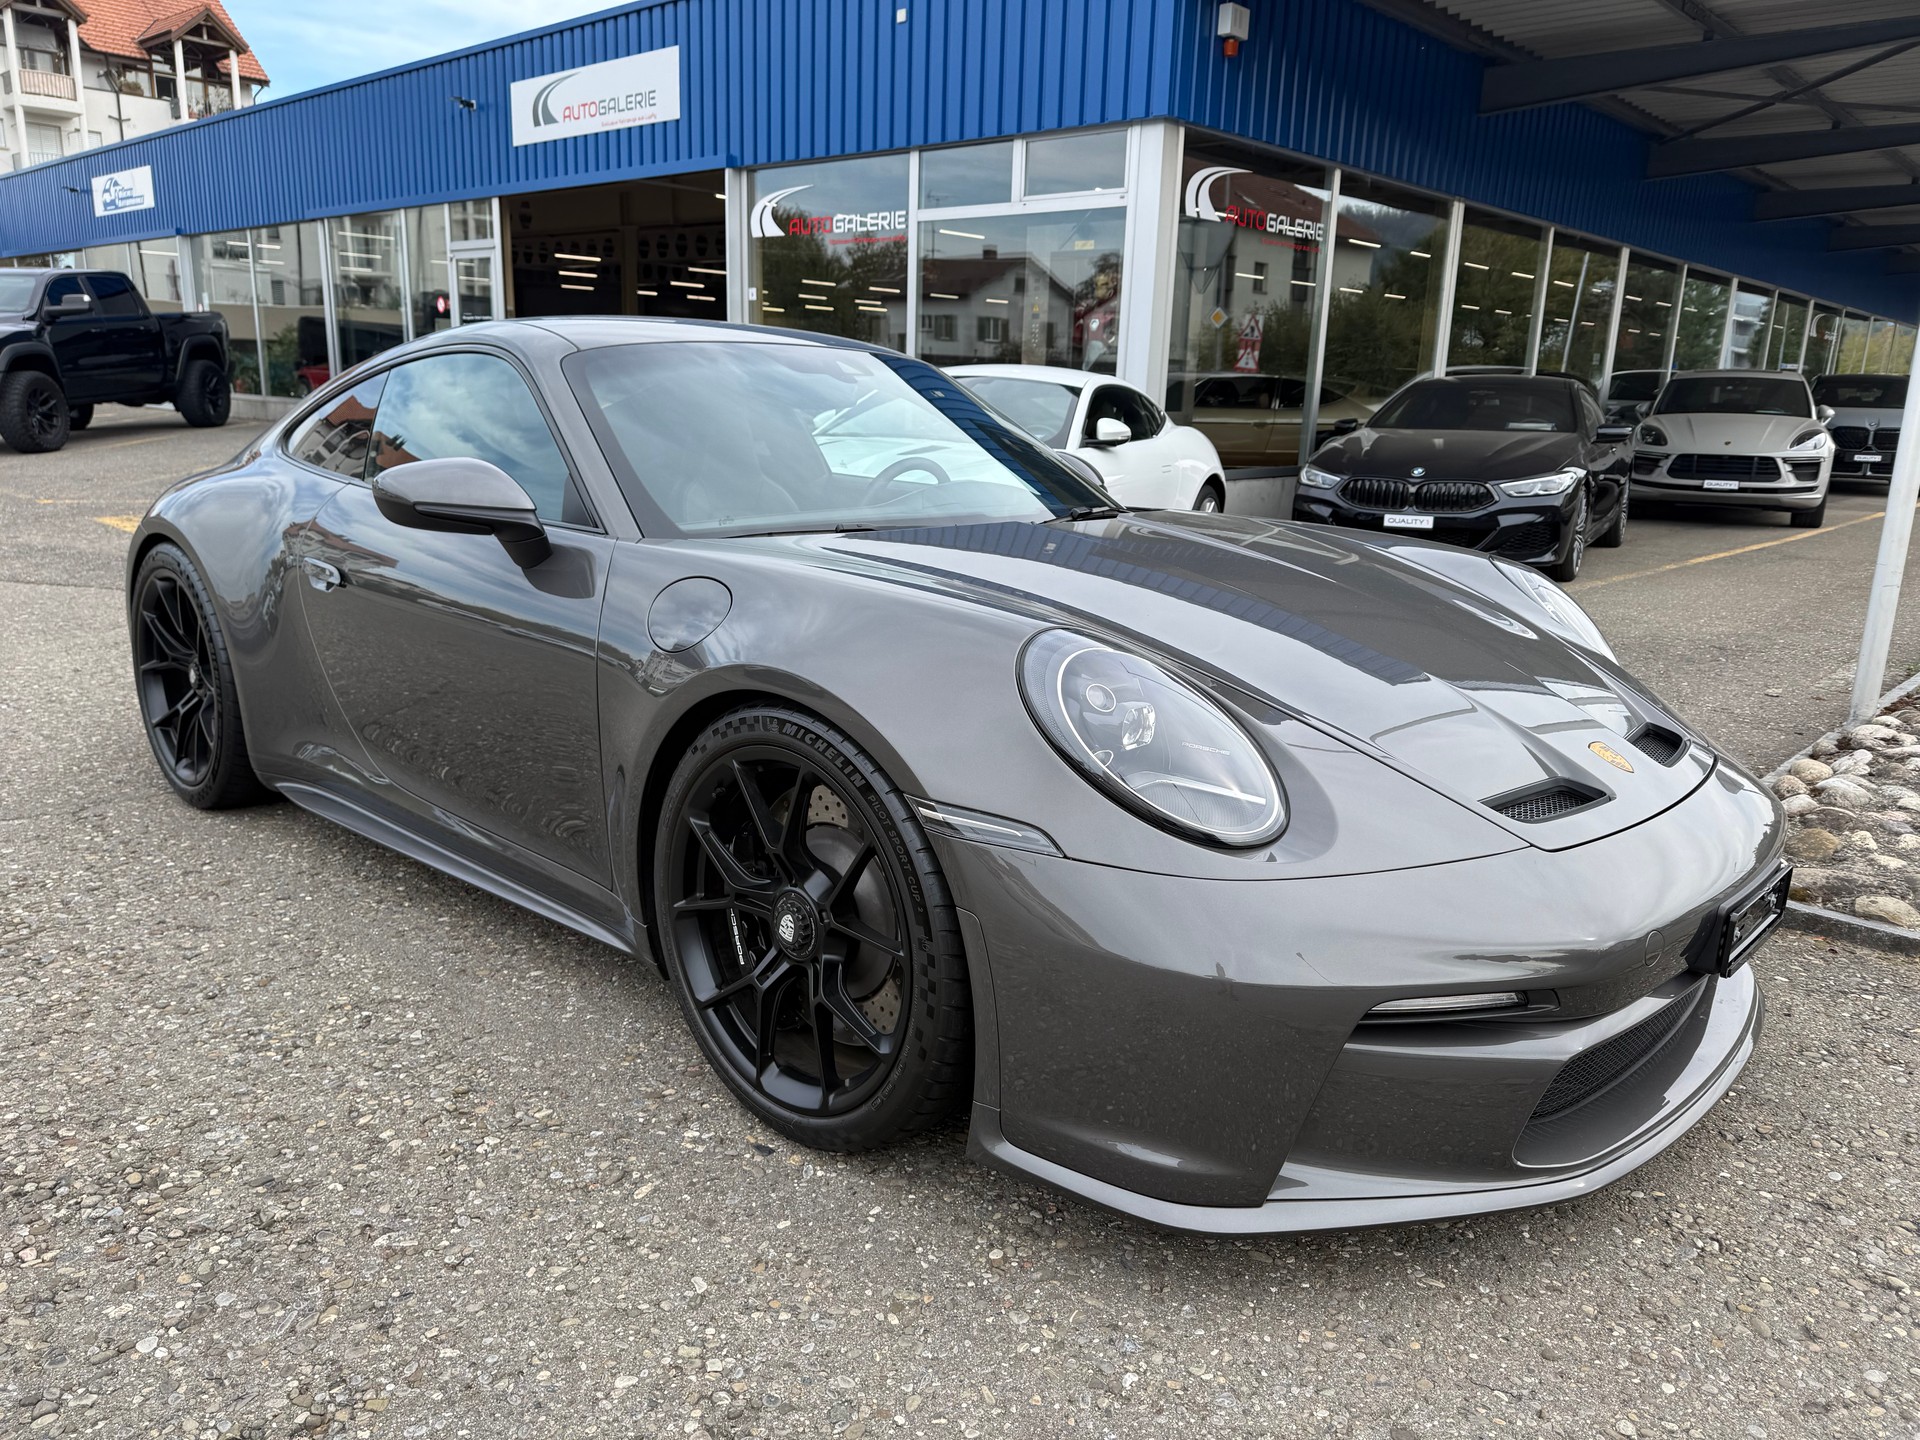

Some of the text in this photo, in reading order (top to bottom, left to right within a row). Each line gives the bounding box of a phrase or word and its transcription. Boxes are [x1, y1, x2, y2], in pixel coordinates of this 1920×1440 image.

[563, 89, 657, 123] AUTOGALERIE
[788, 210, 907, 236] AUTOGALERIE
[1225, 205, 1325, 241] AUTOGALERIE
[1387, 517, 1424, 525] QUALITY
[1181, 741, 1231, 756] PORSCHE
[782, 722, 867, 788] MICHELIN
[867, 794, 892, 826] PILOT
[888, 829, 912, 872] SPORT
[908, 876, 921, 902] CUP
